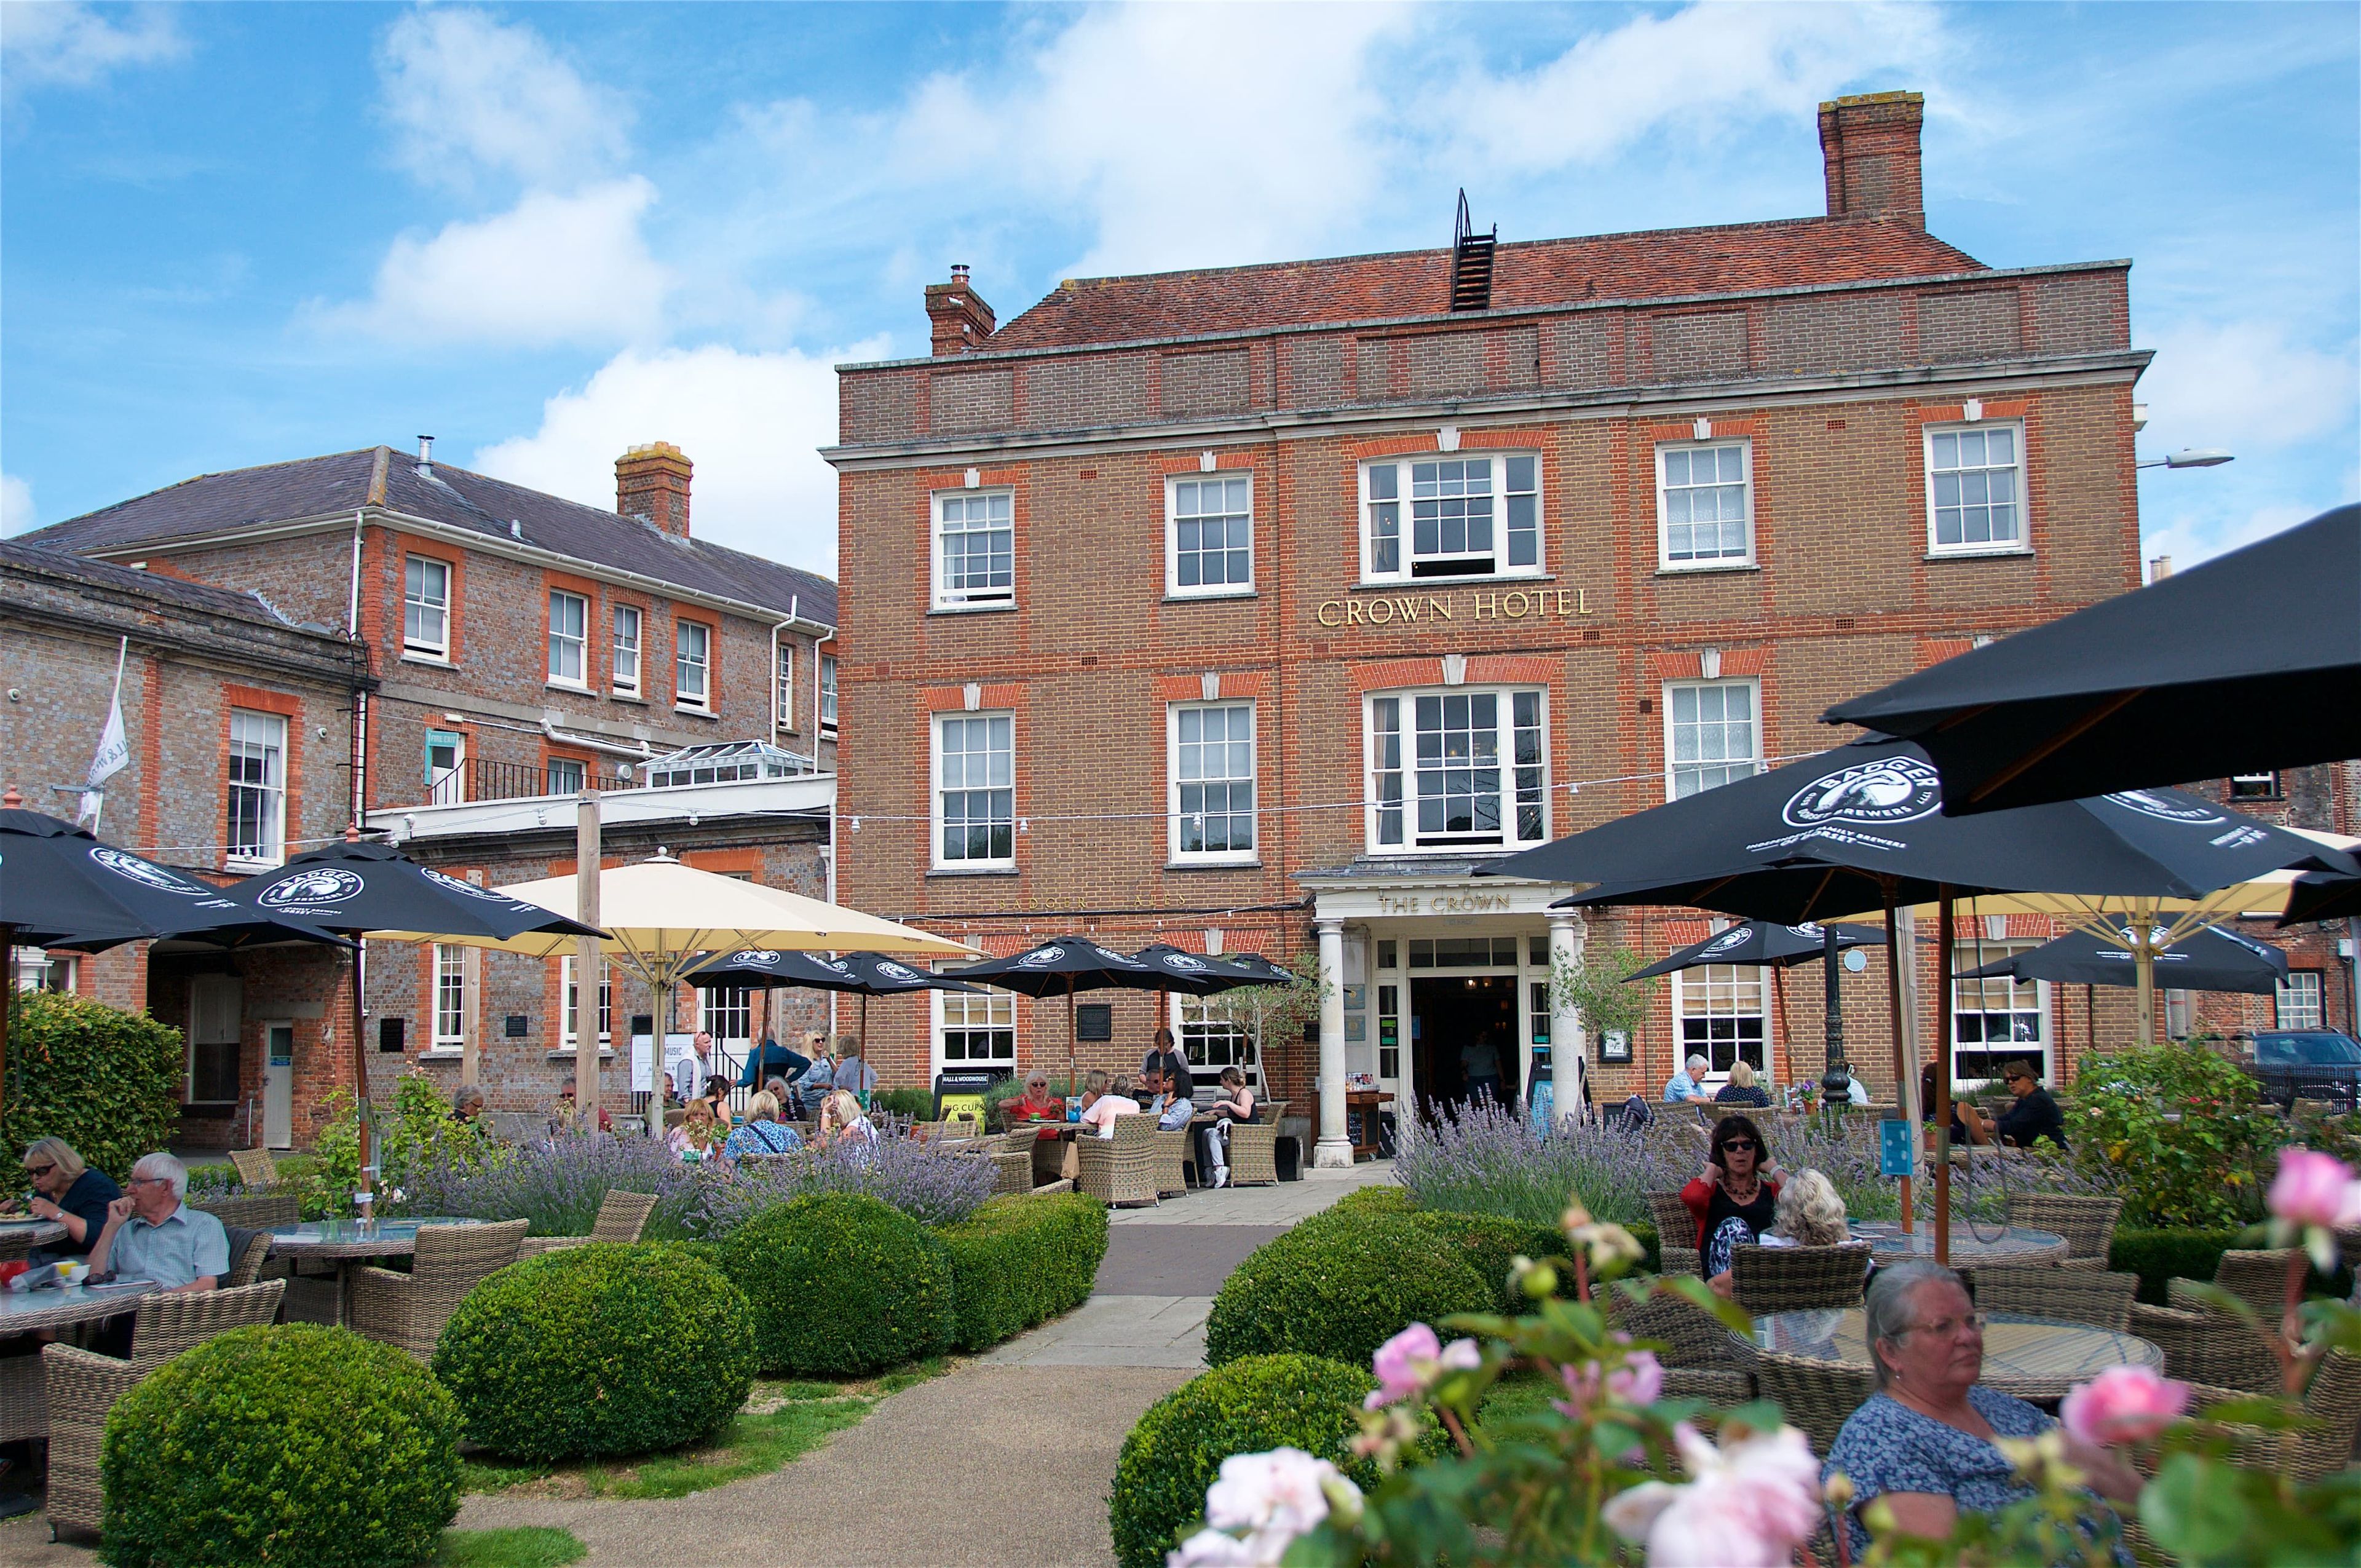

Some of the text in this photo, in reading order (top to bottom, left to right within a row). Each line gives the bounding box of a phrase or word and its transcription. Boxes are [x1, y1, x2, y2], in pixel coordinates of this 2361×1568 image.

[1318, 588, 1593, 627] CROWN HOTEL
[1817, 759, 1939, 789] BADGER
[1833, 806, 1912, 817] BREWERS
[1856, 833, 1907, 848] BREWERS
[279, 871, 357, 887] BADGER
[1378, 893, 1509, 912] THE CROWN
